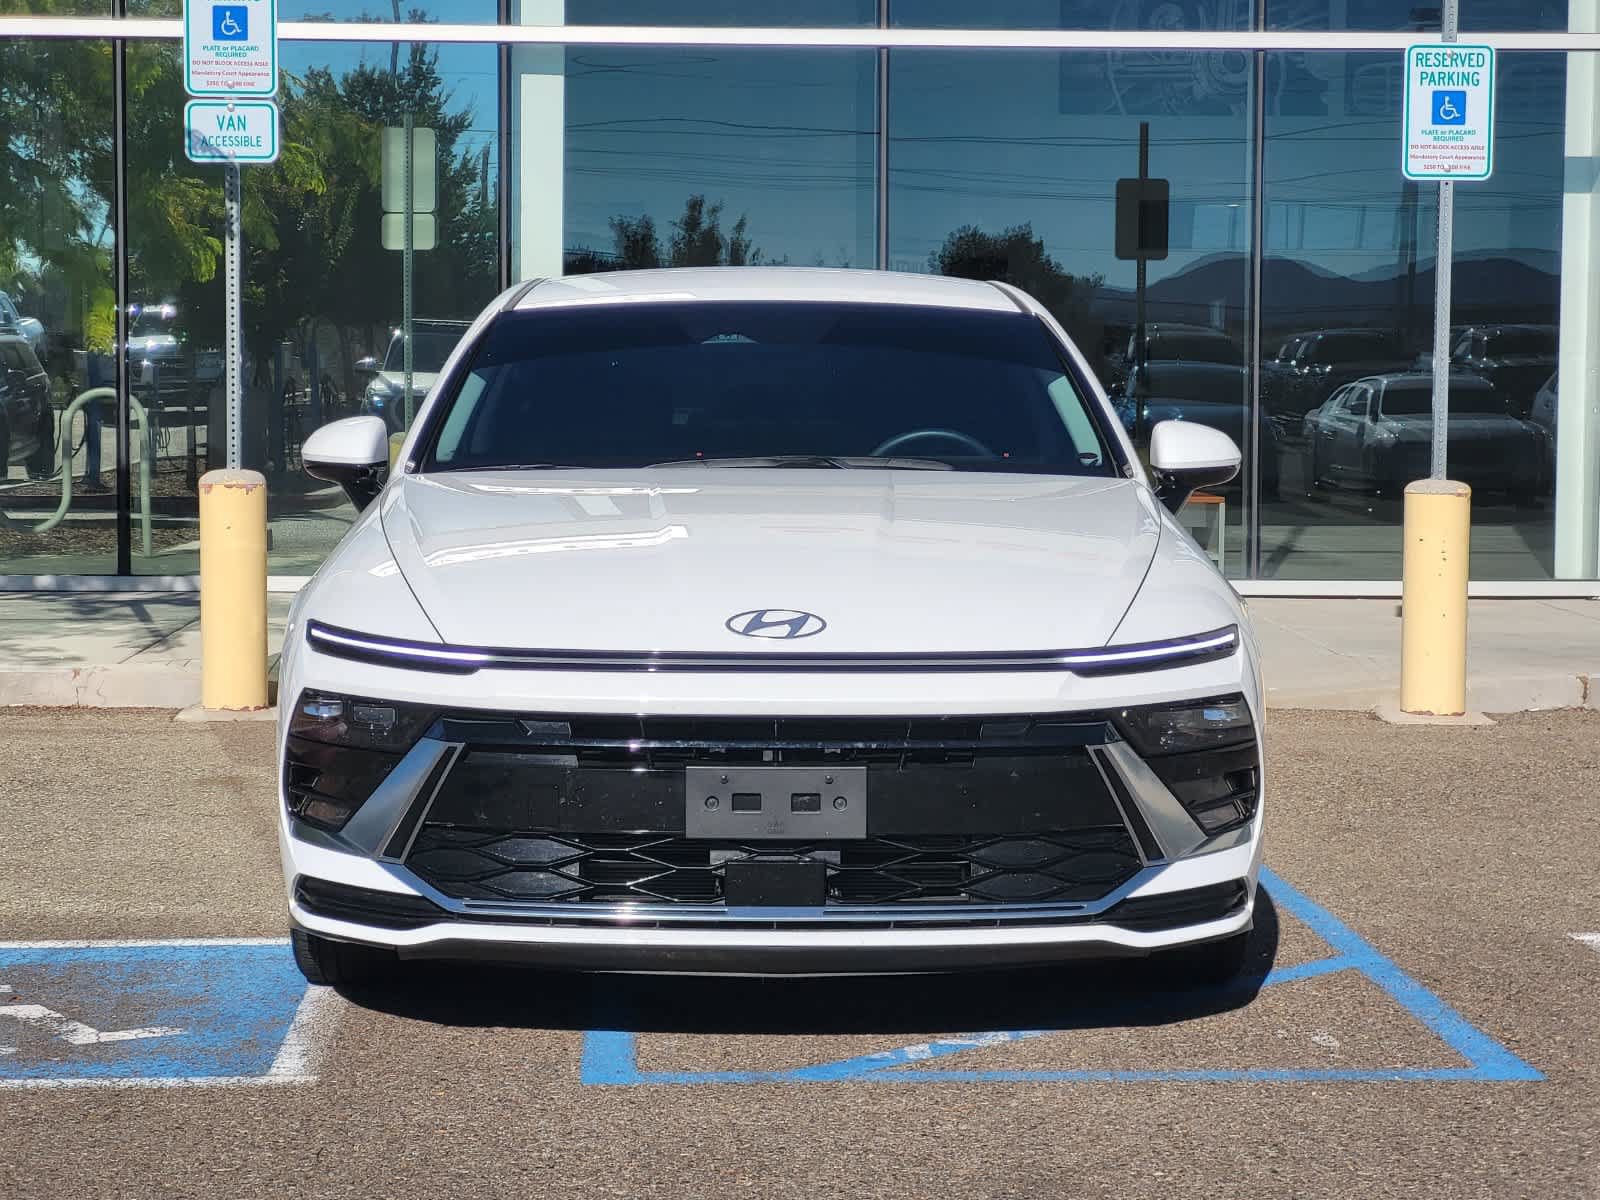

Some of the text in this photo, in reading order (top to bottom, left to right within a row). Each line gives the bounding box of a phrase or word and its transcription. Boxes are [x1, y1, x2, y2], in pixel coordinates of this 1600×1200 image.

[1415, 52, 1485, 67] RESERVED
[1420, 71, 1481, 86] PARKING
[216, 114, 247, 131] VAN
[201, 135, 263, 147] ACCESSIBLE
